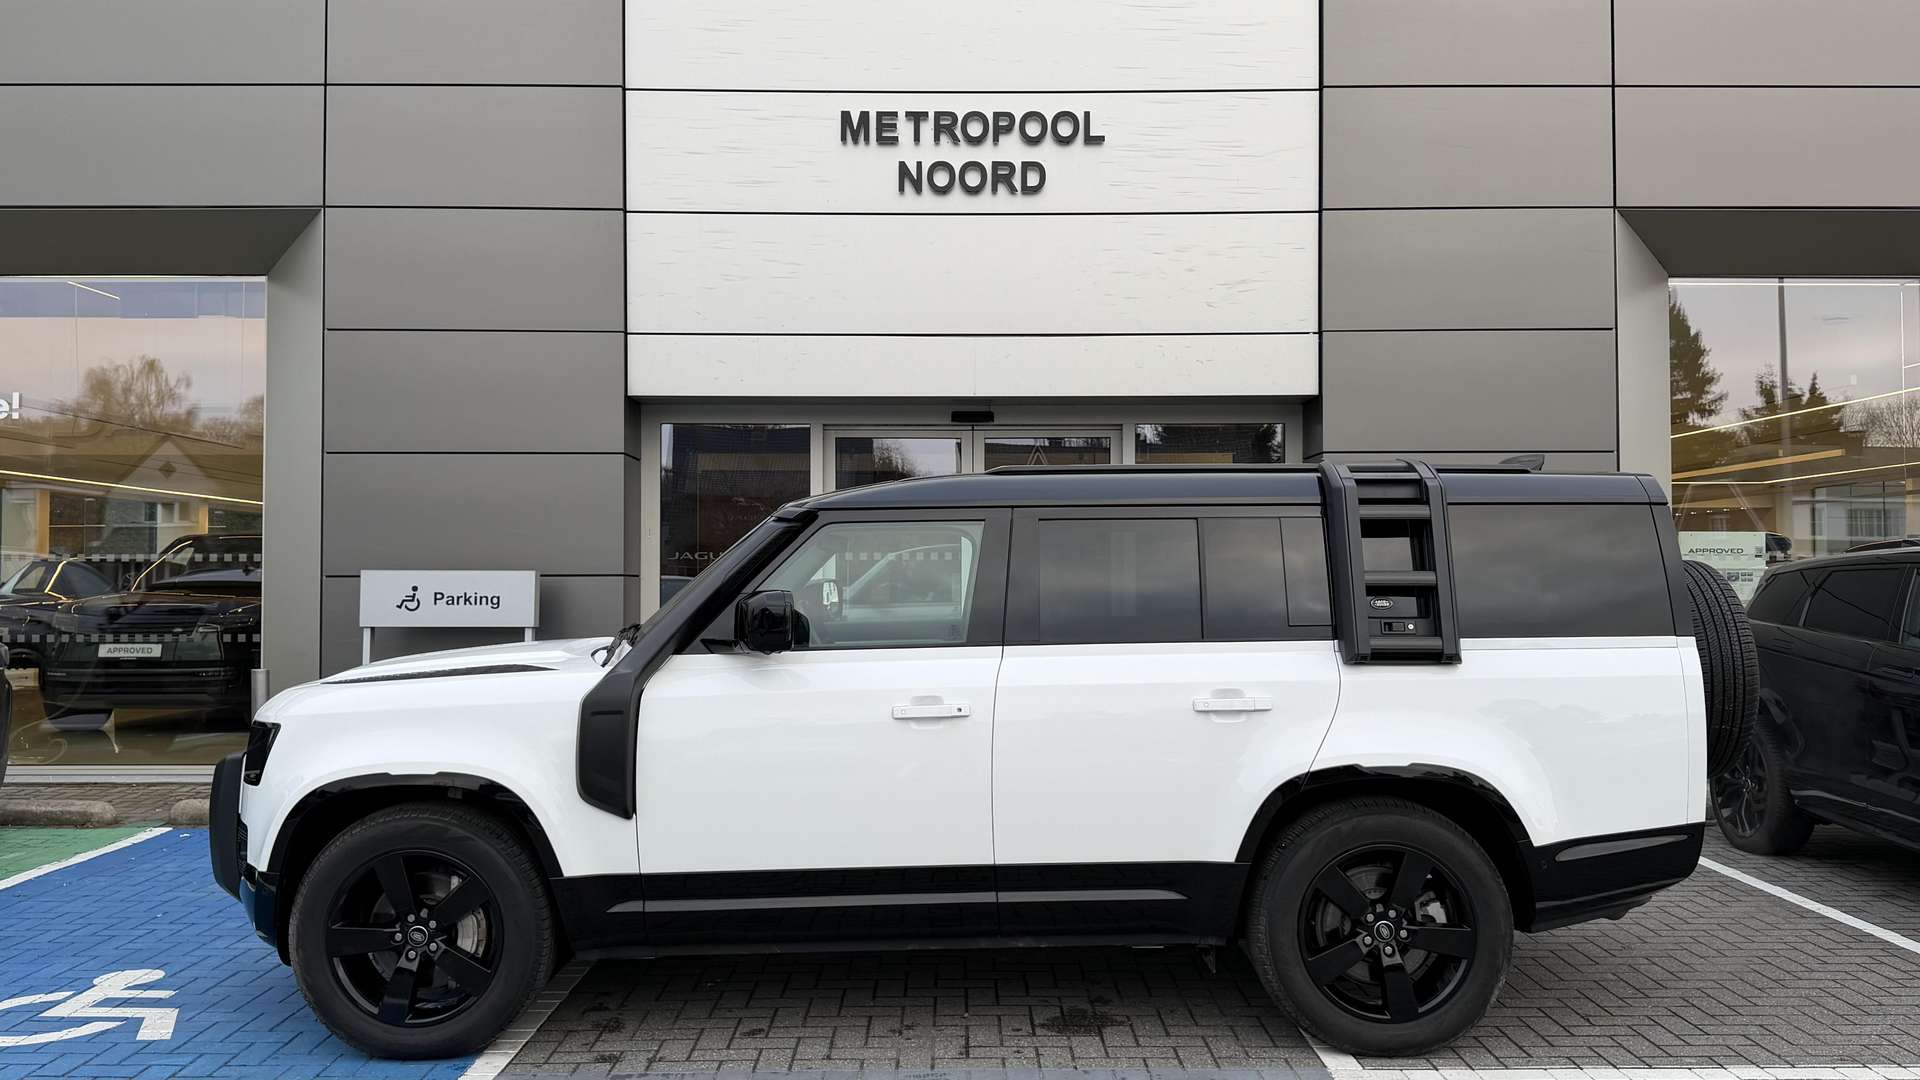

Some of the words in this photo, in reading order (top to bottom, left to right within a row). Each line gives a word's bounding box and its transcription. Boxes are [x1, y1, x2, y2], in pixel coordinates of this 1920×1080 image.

[840, 110, 1106, 145] METROPOOL
[897, 160, 1047, 194] NOORD
[433, 591, 501, 610] Parking
